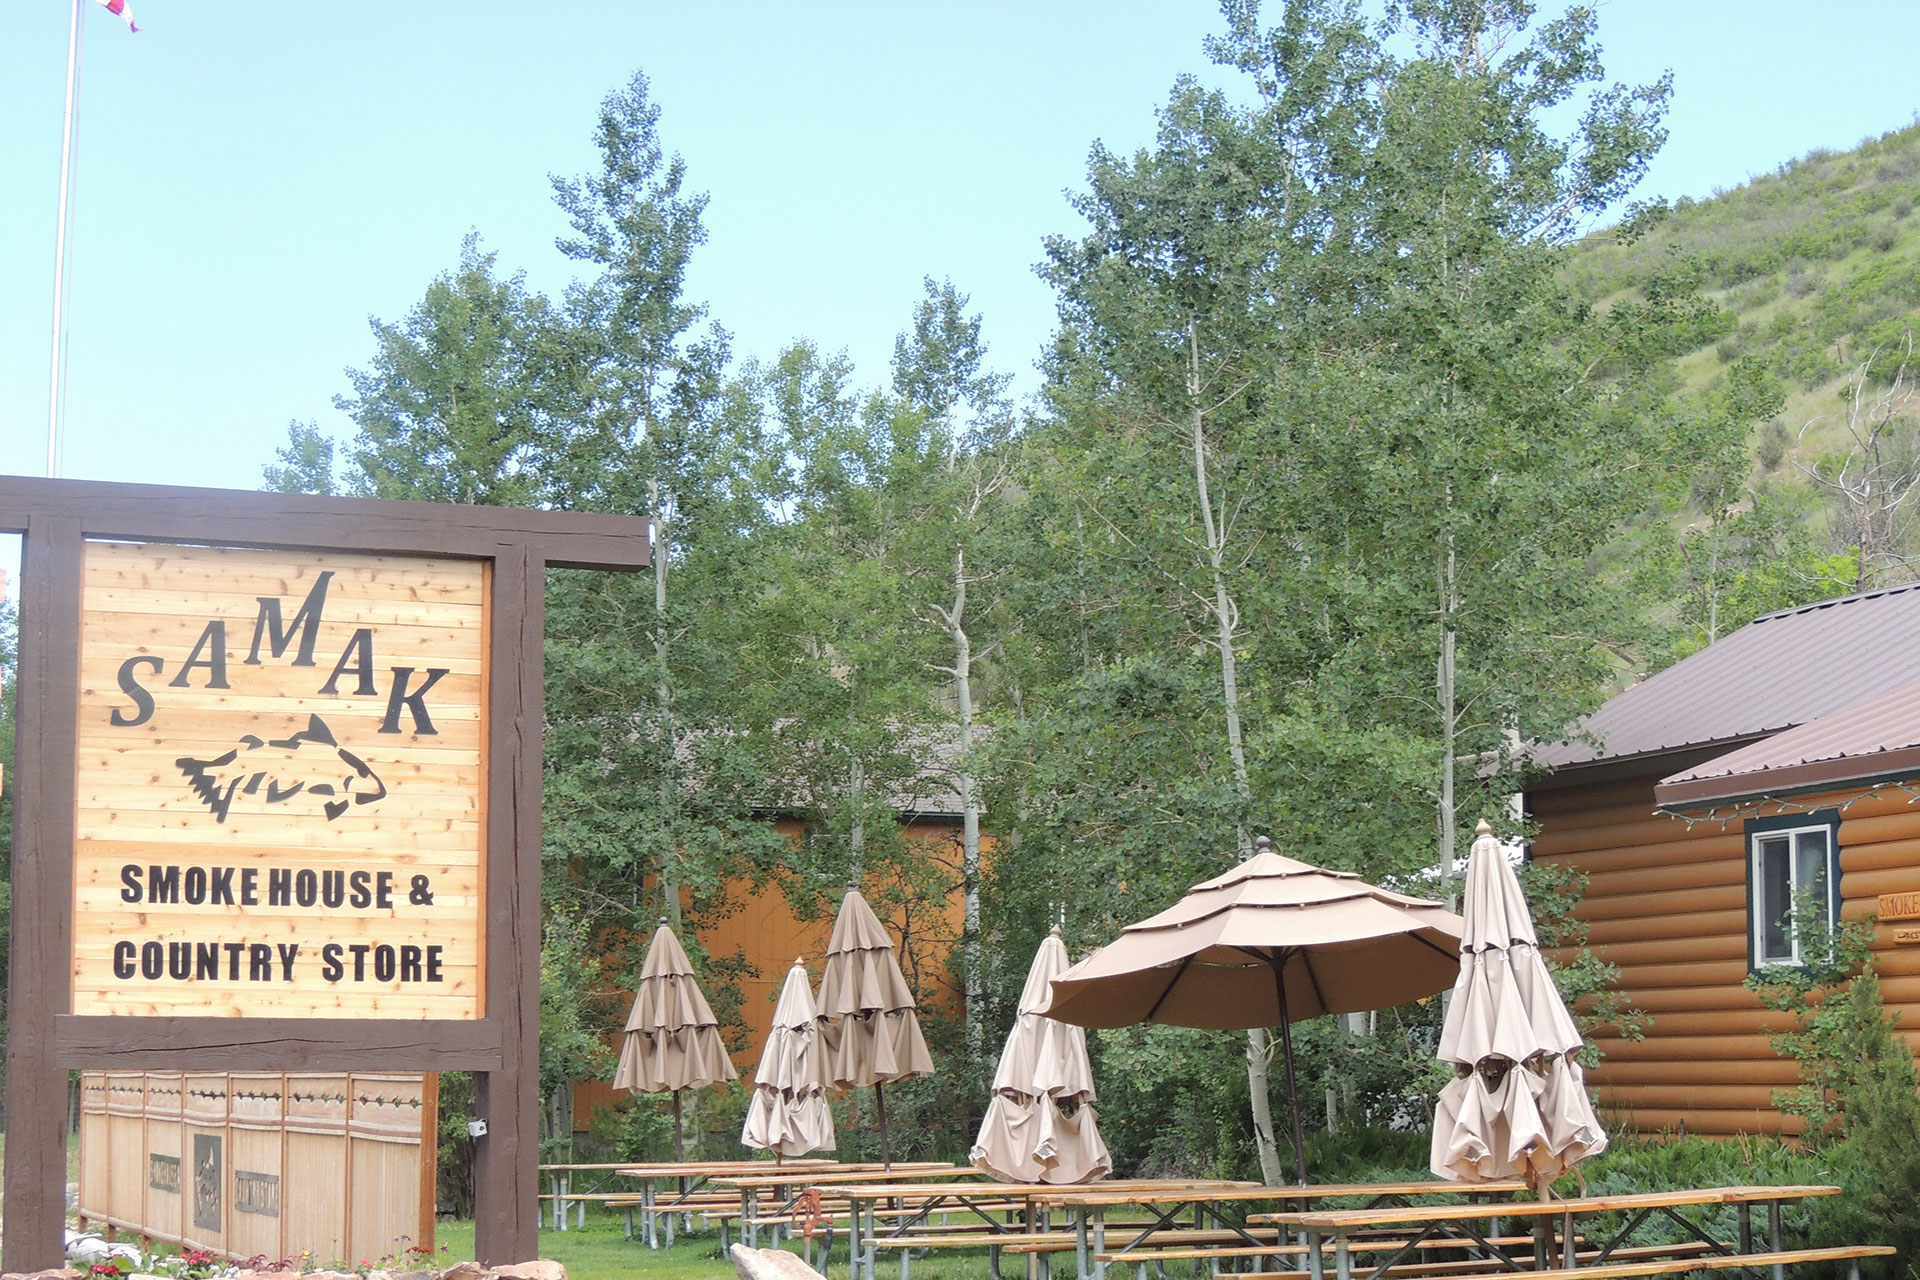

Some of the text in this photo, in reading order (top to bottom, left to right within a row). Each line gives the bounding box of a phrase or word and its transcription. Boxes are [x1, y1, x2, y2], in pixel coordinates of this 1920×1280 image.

[110, 570, 450, 735] SAMAK
[409, 874, 434, 906] &
[113, 940, 443, 982] COUNTRY STORE
